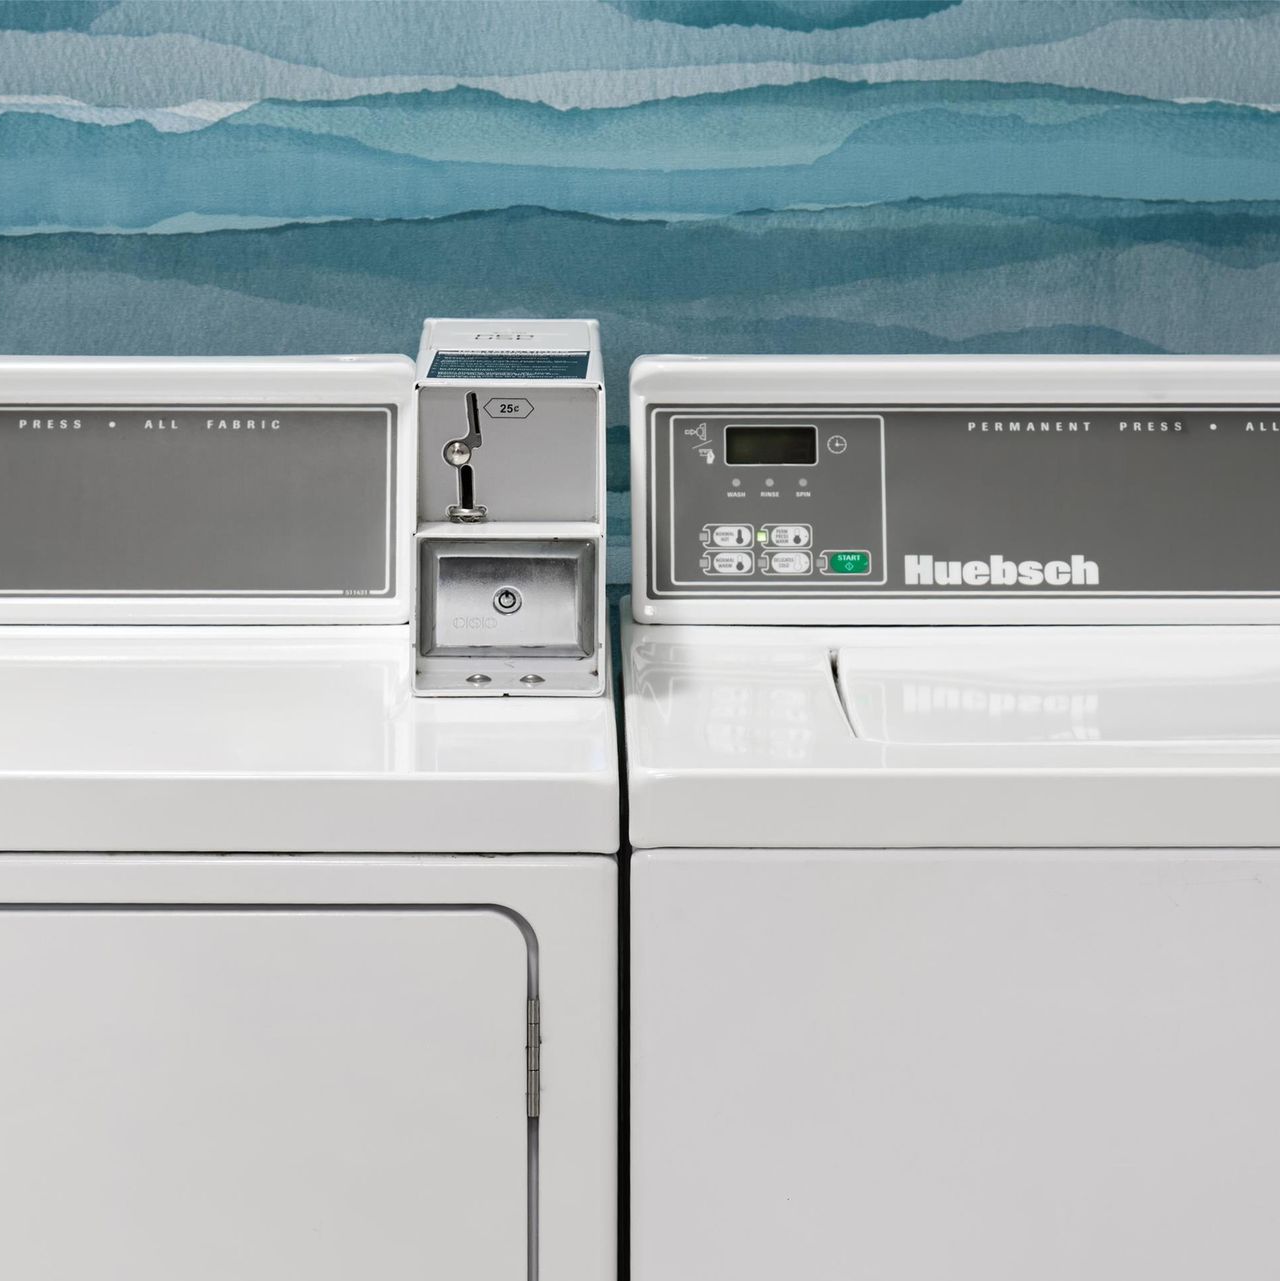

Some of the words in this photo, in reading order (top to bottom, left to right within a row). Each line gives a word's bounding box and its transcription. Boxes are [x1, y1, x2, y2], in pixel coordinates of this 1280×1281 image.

[19, 419, 81, 429] PRESS
[144, 419, 178, 429] ALL
[206, 419, 280, 430] FABRIC
[968, 422, 1090, 432] PERMANENT
[1119, 422, 1182, 432] PRESS
[1245, 422, 1279, 432] ALL
[904, 554, 1100, 586] Huebsch
